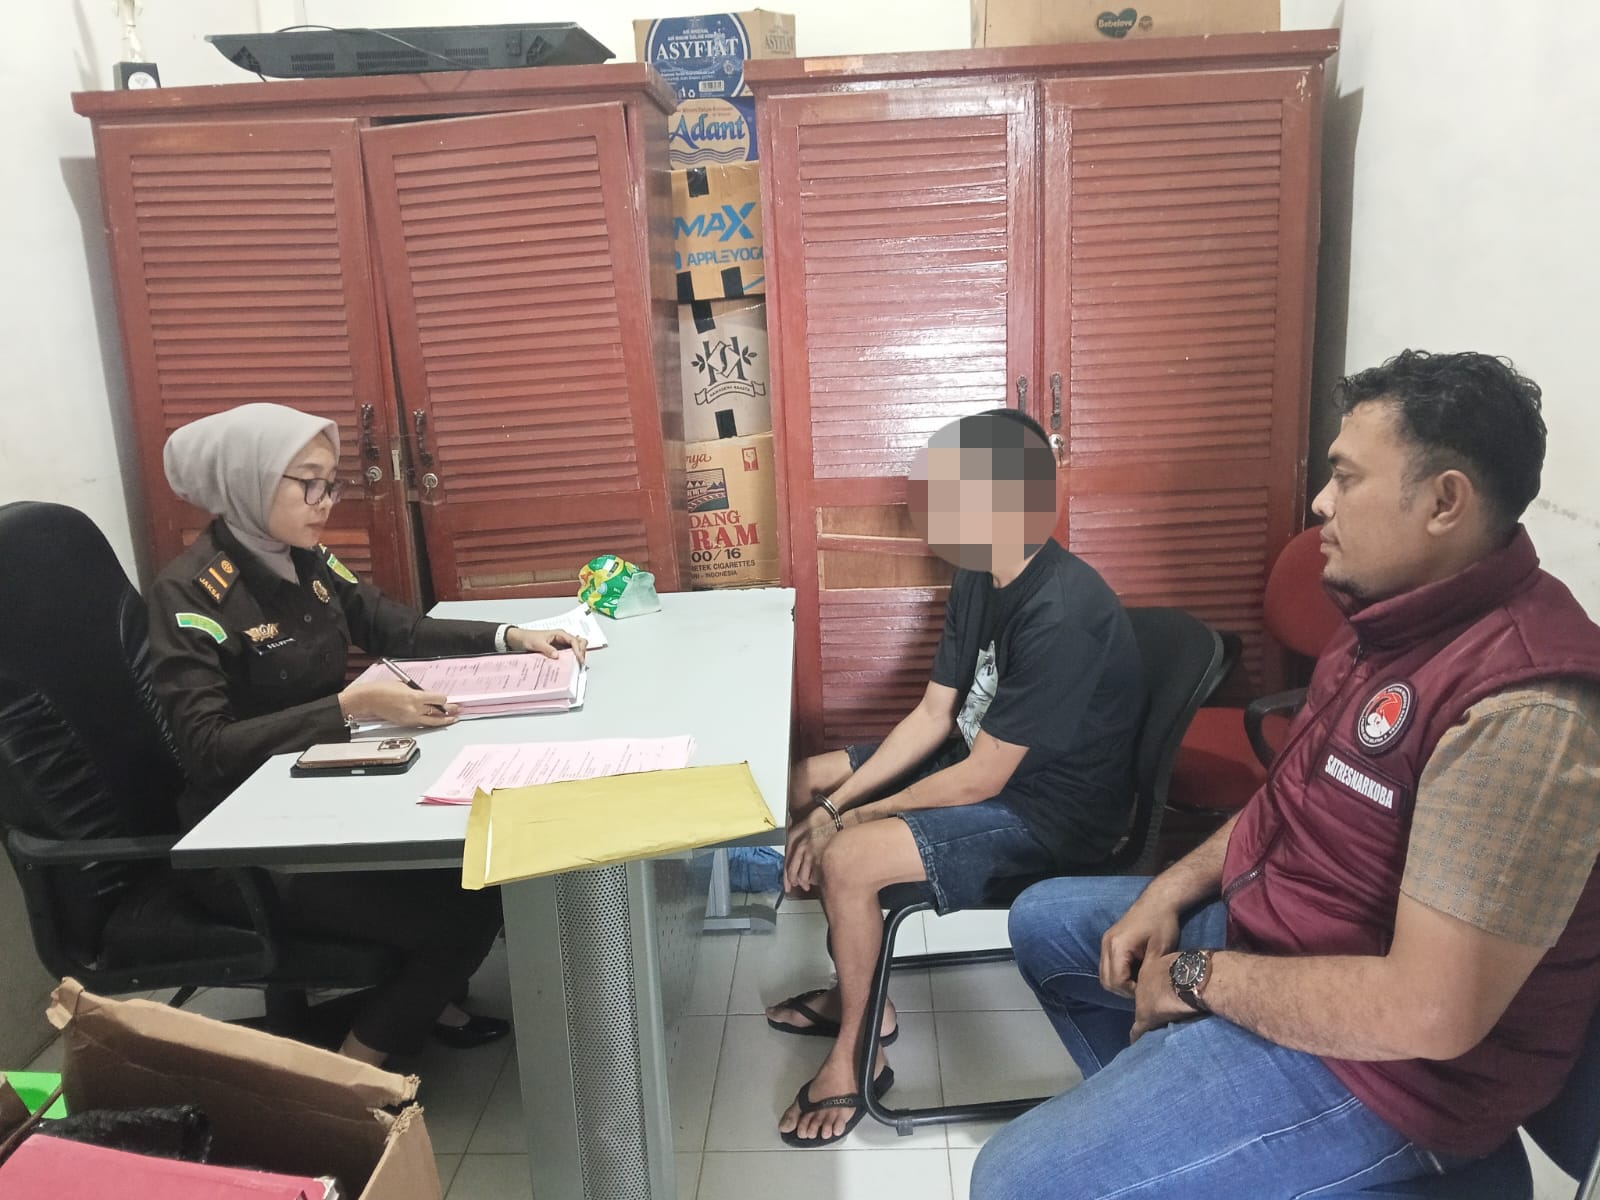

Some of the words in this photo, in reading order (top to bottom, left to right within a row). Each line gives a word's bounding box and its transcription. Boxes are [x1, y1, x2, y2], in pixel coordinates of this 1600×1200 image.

[656, 38, 739, 61] ASYFIAT
[669, 113, 746, 149] Adant
[673, 202, 757, 242] MAX
[705, 569, 738, 578] INDONESIA
[713, 559, 756, 570] CIGARETTES
[1324, 754, 1395, 809] SATRESNARKOBA
